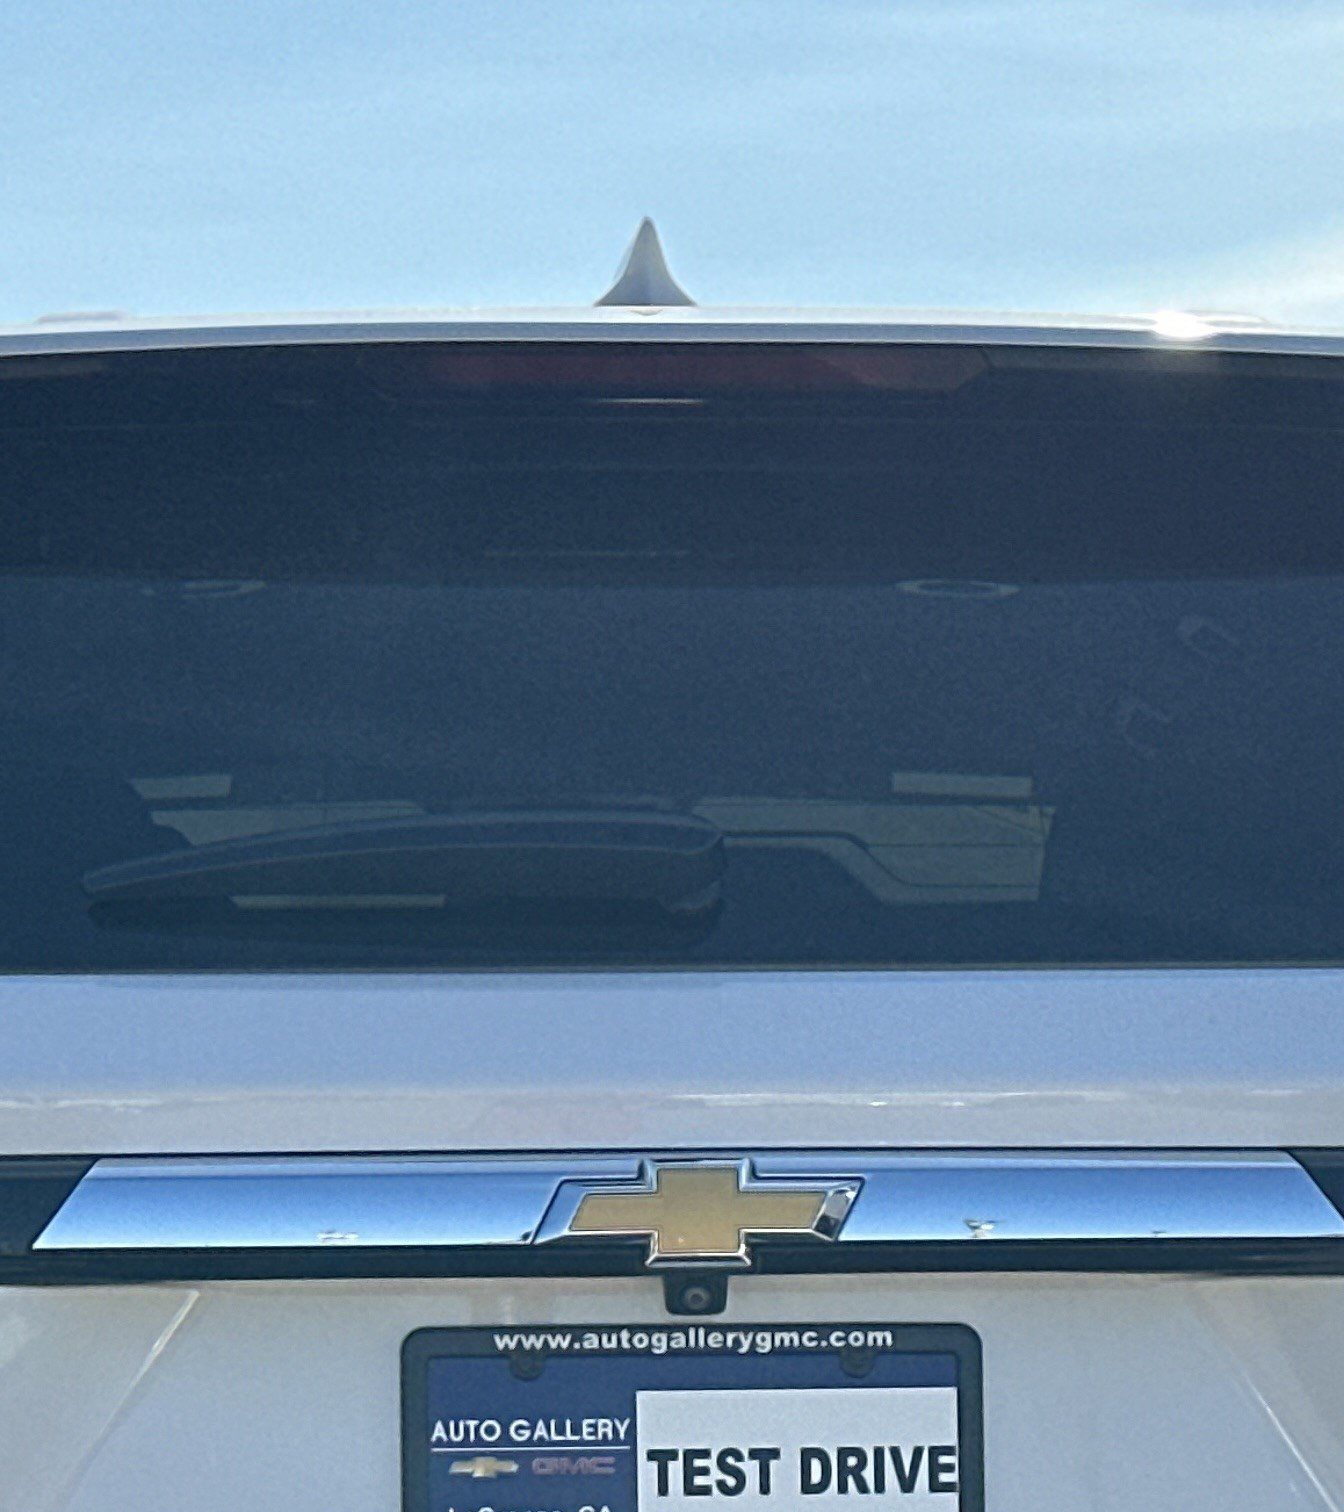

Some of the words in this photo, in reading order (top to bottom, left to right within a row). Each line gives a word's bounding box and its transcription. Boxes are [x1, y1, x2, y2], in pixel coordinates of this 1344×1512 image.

[493, 1327, 894, 1354] www.autogallerygmc.com
[431, 1419, 501, 1443] AUTO
[509, 1418, 631, 1442] GALLERY
[532, 1456, 616, 1475] GMC
[646, 1447, 781, 1497] TEST
[799, 1445, 959, 1495] DRIVE
